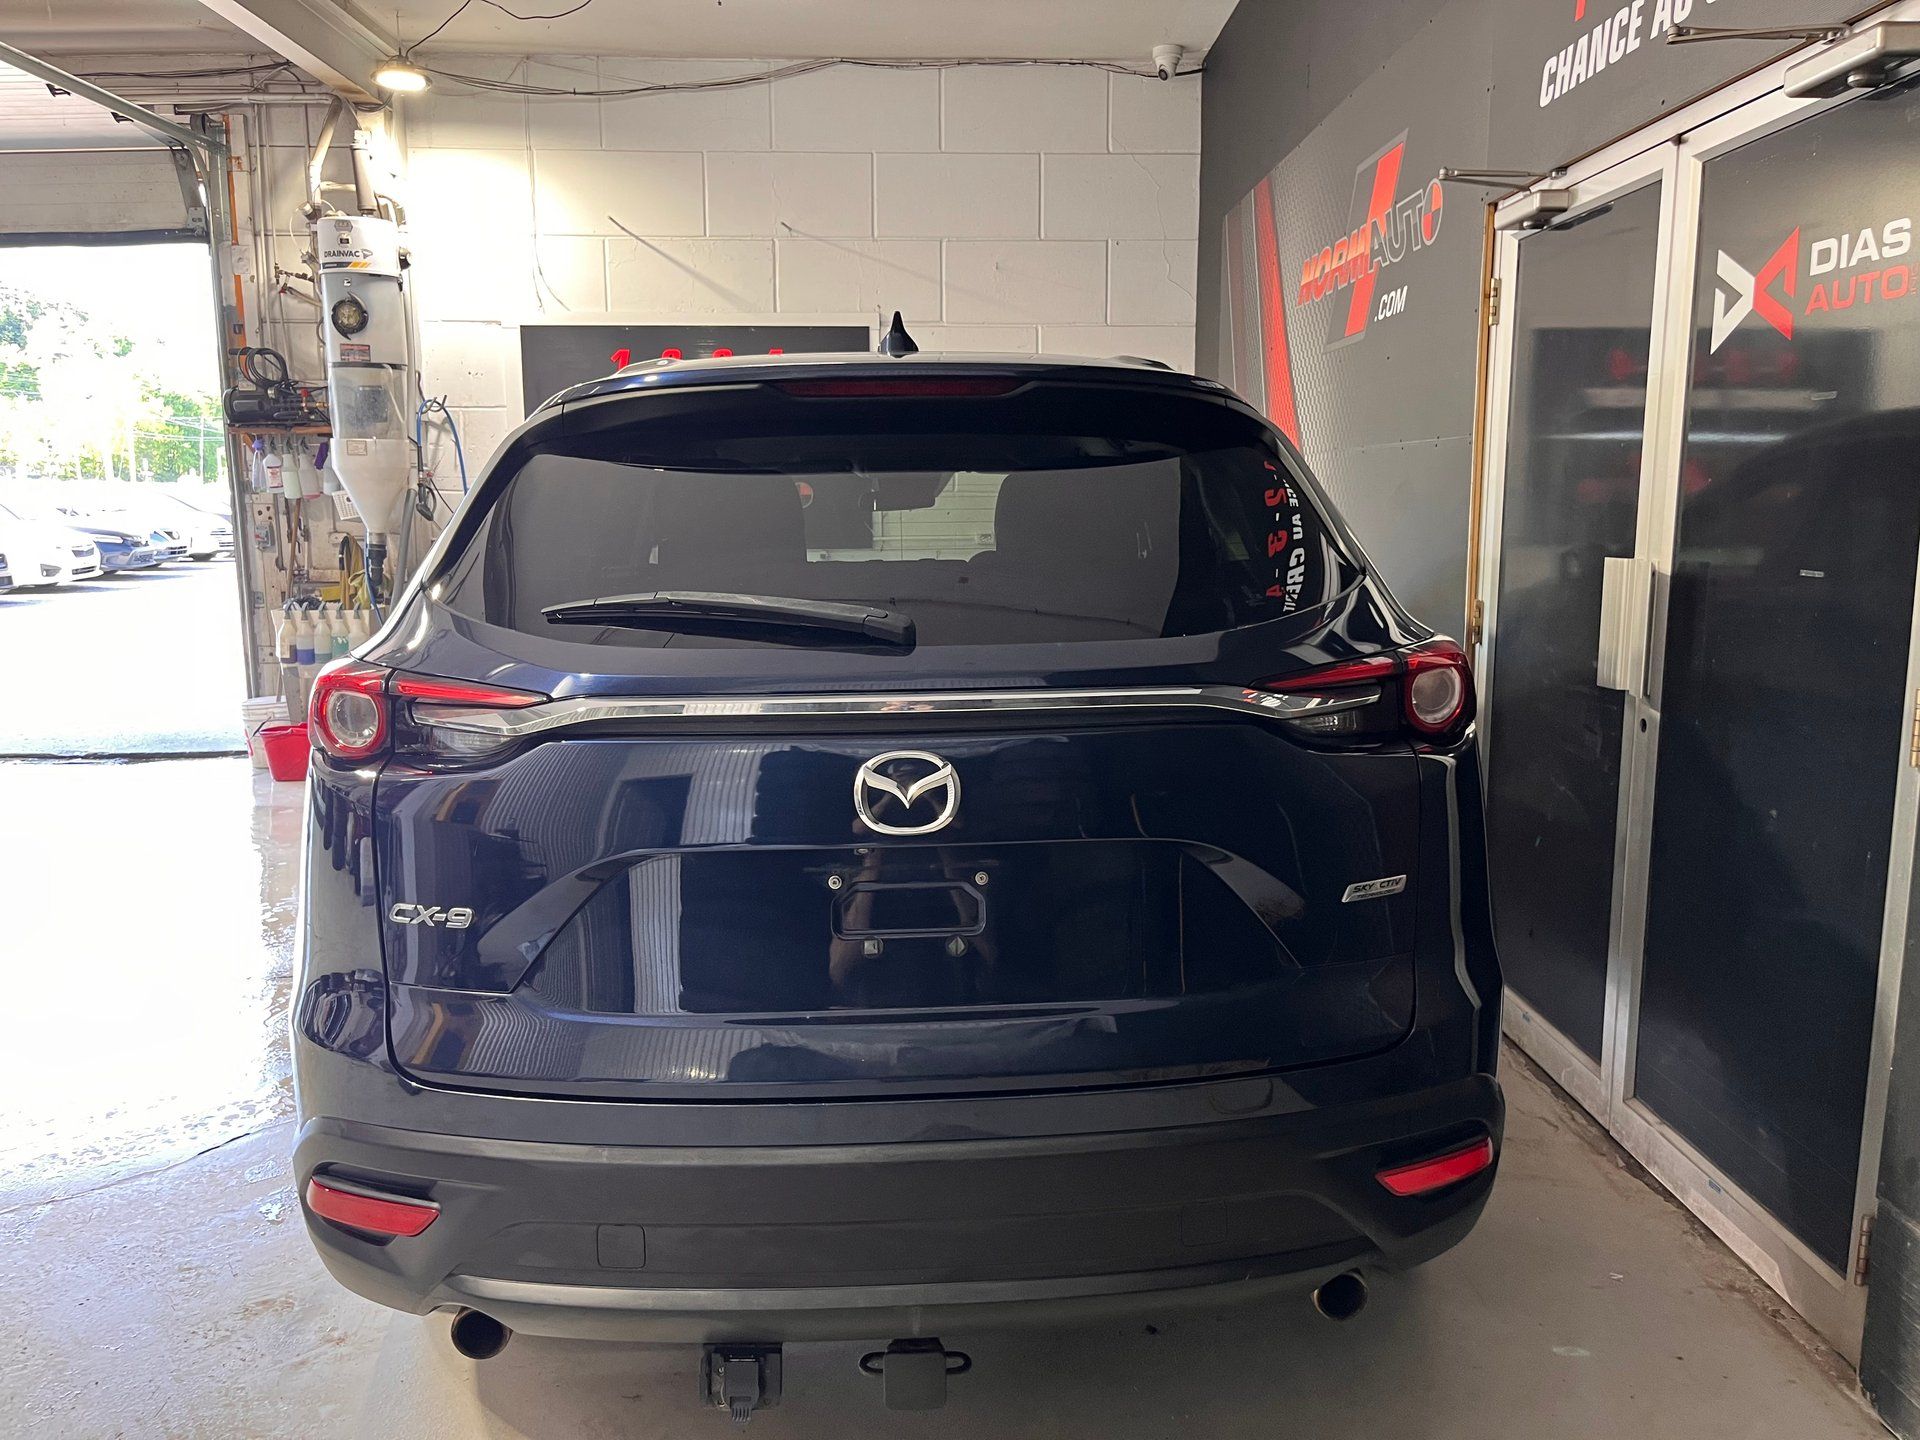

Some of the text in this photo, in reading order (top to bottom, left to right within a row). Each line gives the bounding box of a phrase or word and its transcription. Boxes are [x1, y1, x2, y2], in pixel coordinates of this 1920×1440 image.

[1539, 0, 1645, 108] CHANCE
[324, 250, 360, 258] DRAINVAC
[1809, 217, 1912, 276] DIAS
[1374, 285, 1408, 322] .COM
[1805, 264, 1910, 316] AUTO
[389, 903, 473, 929] CX-9
